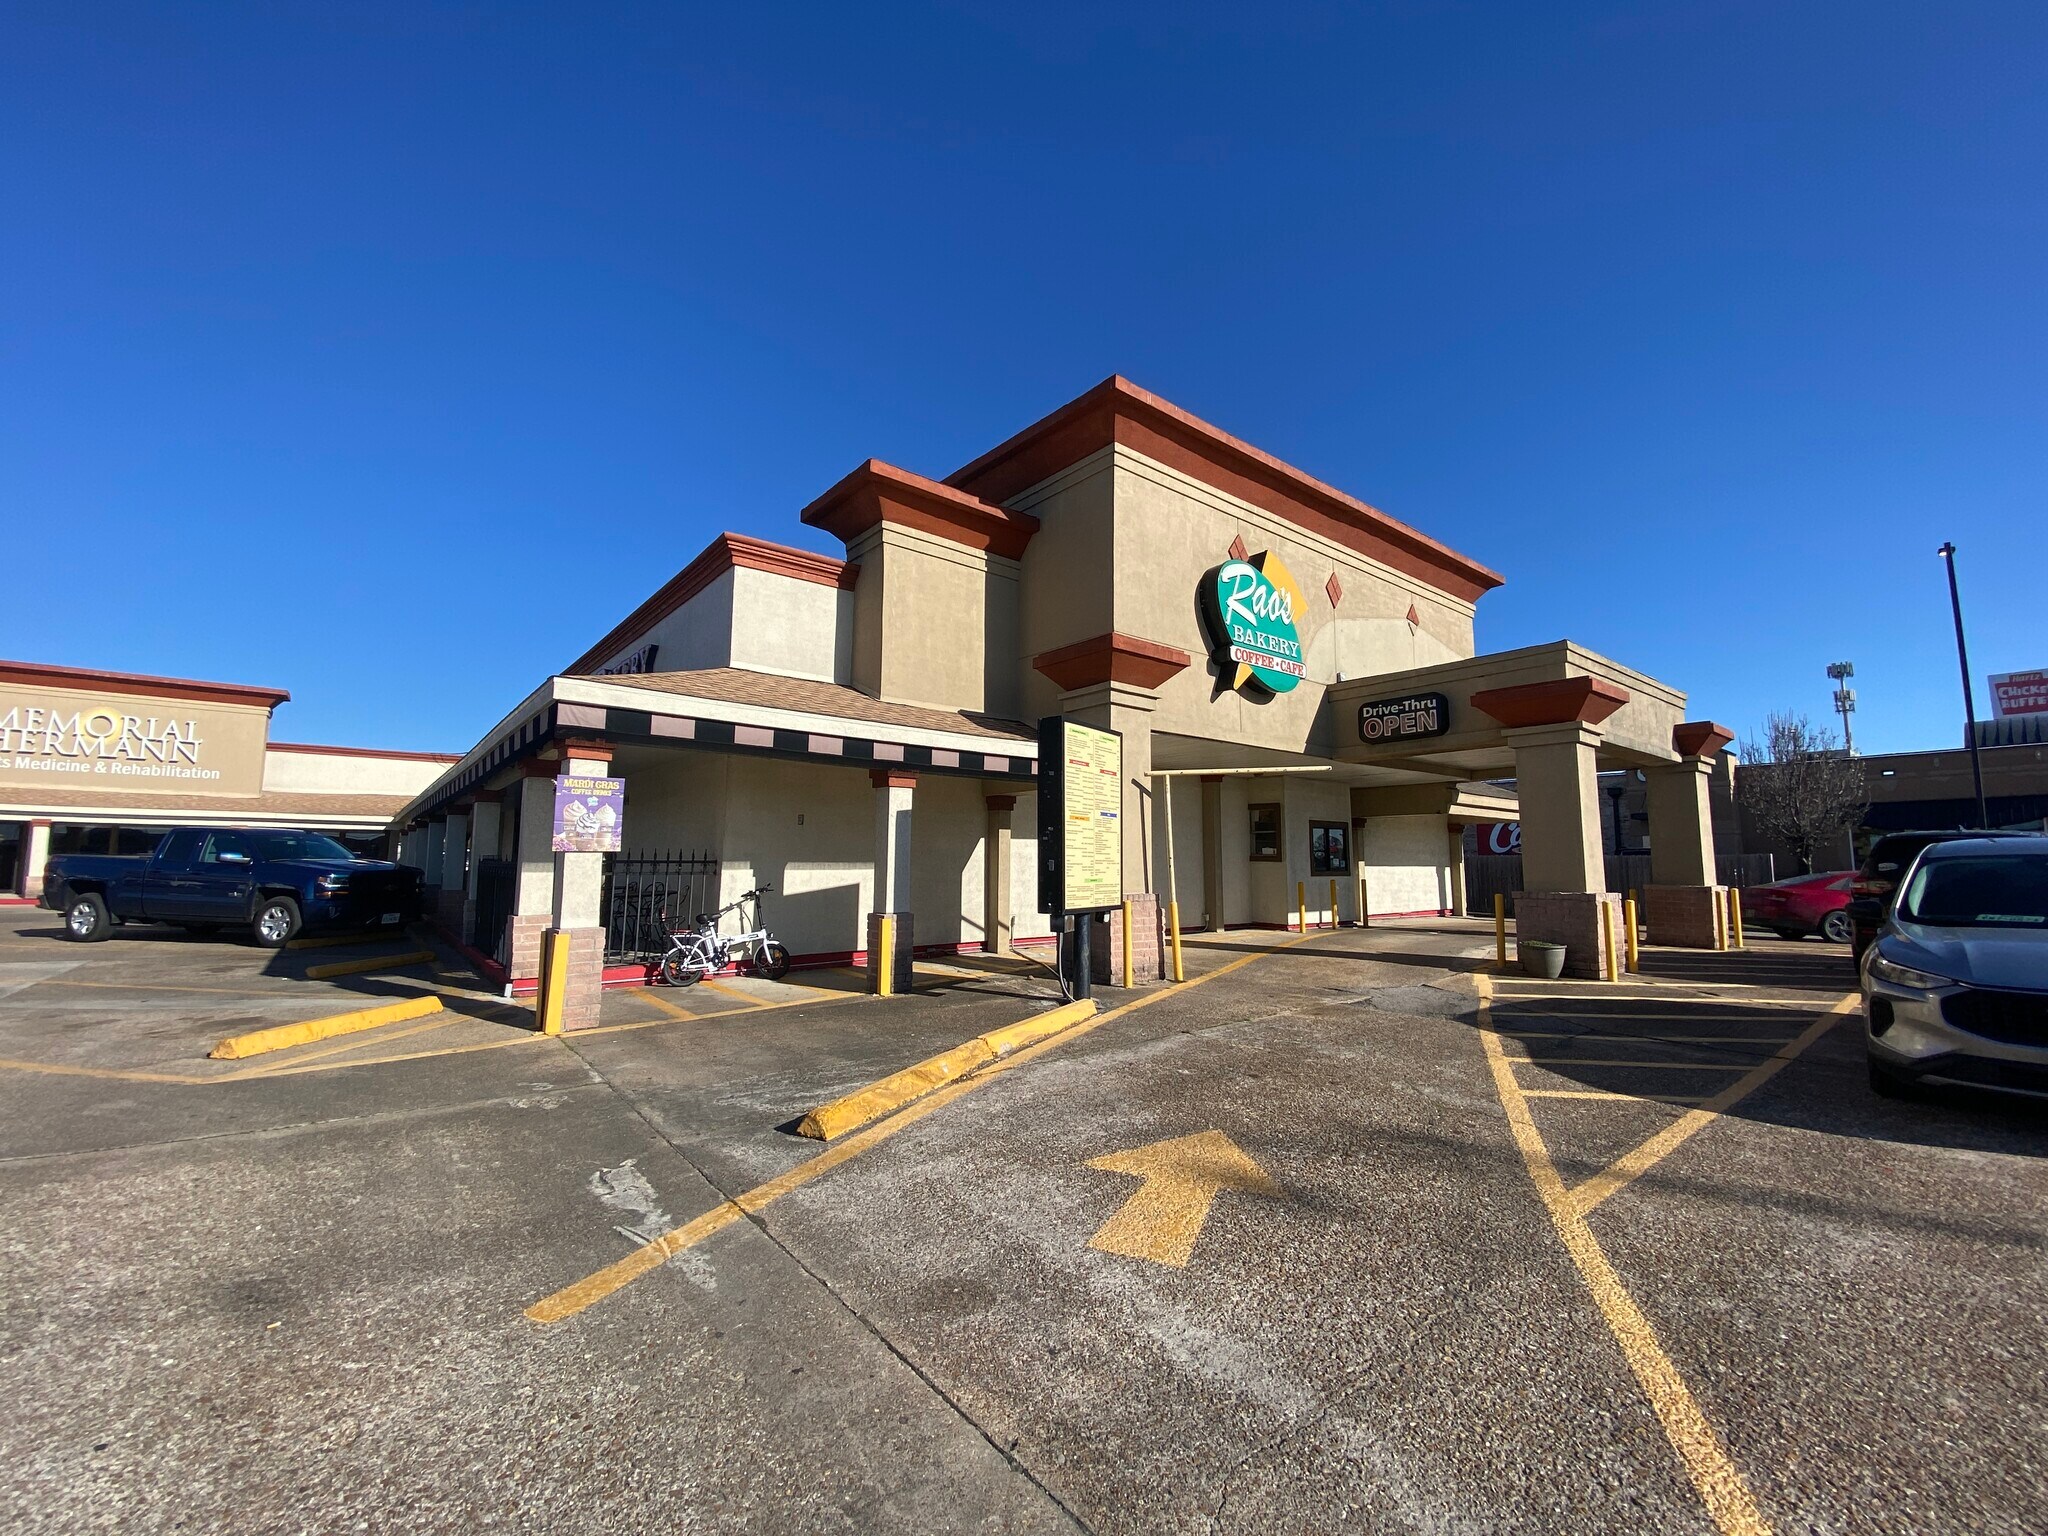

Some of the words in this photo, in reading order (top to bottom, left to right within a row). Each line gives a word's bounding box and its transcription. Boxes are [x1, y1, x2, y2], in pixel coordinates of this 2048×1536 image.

[1221, 563, 1295, 627] Rao's
[1233, 624, 1299, 658] BAKERY
[1235, 647, 1275, 669] COFFEE
[1280, 659, 1304, 677] CAFE
[1998, 684, 2048, 698] CHICKE
[2002, 696, 2048, 708] BUFFE
[1363, 699, 1437, 718] Drive-Thru
[1363, 709, 1438, 739] OPEN
[15, 756, 91, 773] Medicine
[94, 761, 107, 774] &
[111, 762, 220, 780] Rehabilitation
[563, 779, 594, 789] MARDI
[595, 780, 620, 790] GRAS
